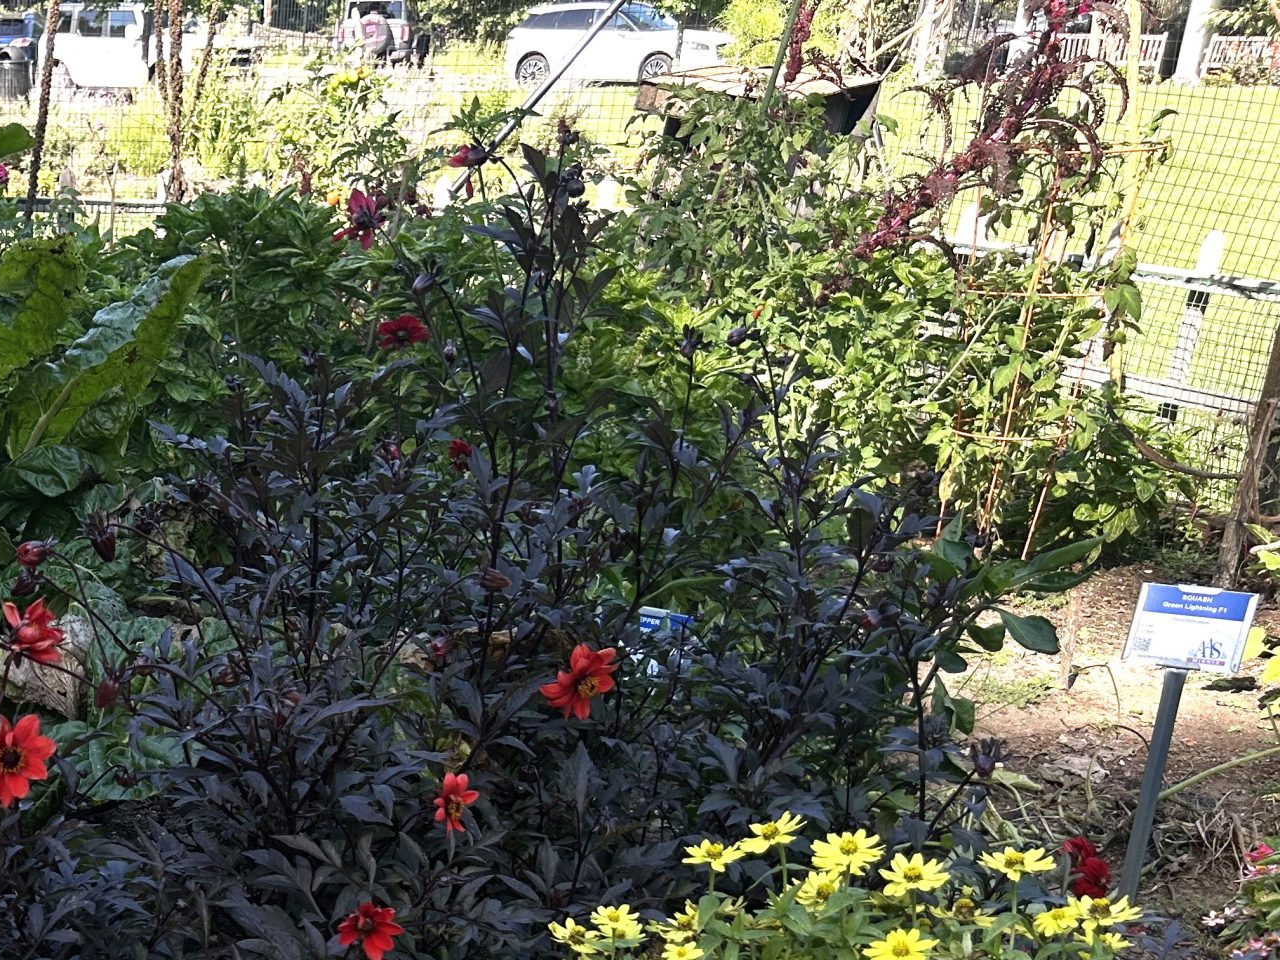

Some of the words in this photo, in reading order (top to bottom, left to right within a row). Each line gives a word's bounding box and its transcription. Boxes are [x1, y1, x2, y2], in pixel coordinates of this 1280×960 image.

[1182, 595, 1213, 603] SQUASH
[1162, 601, 1183, 609] Green
[1184, 603, 1217, 613] Lightning
